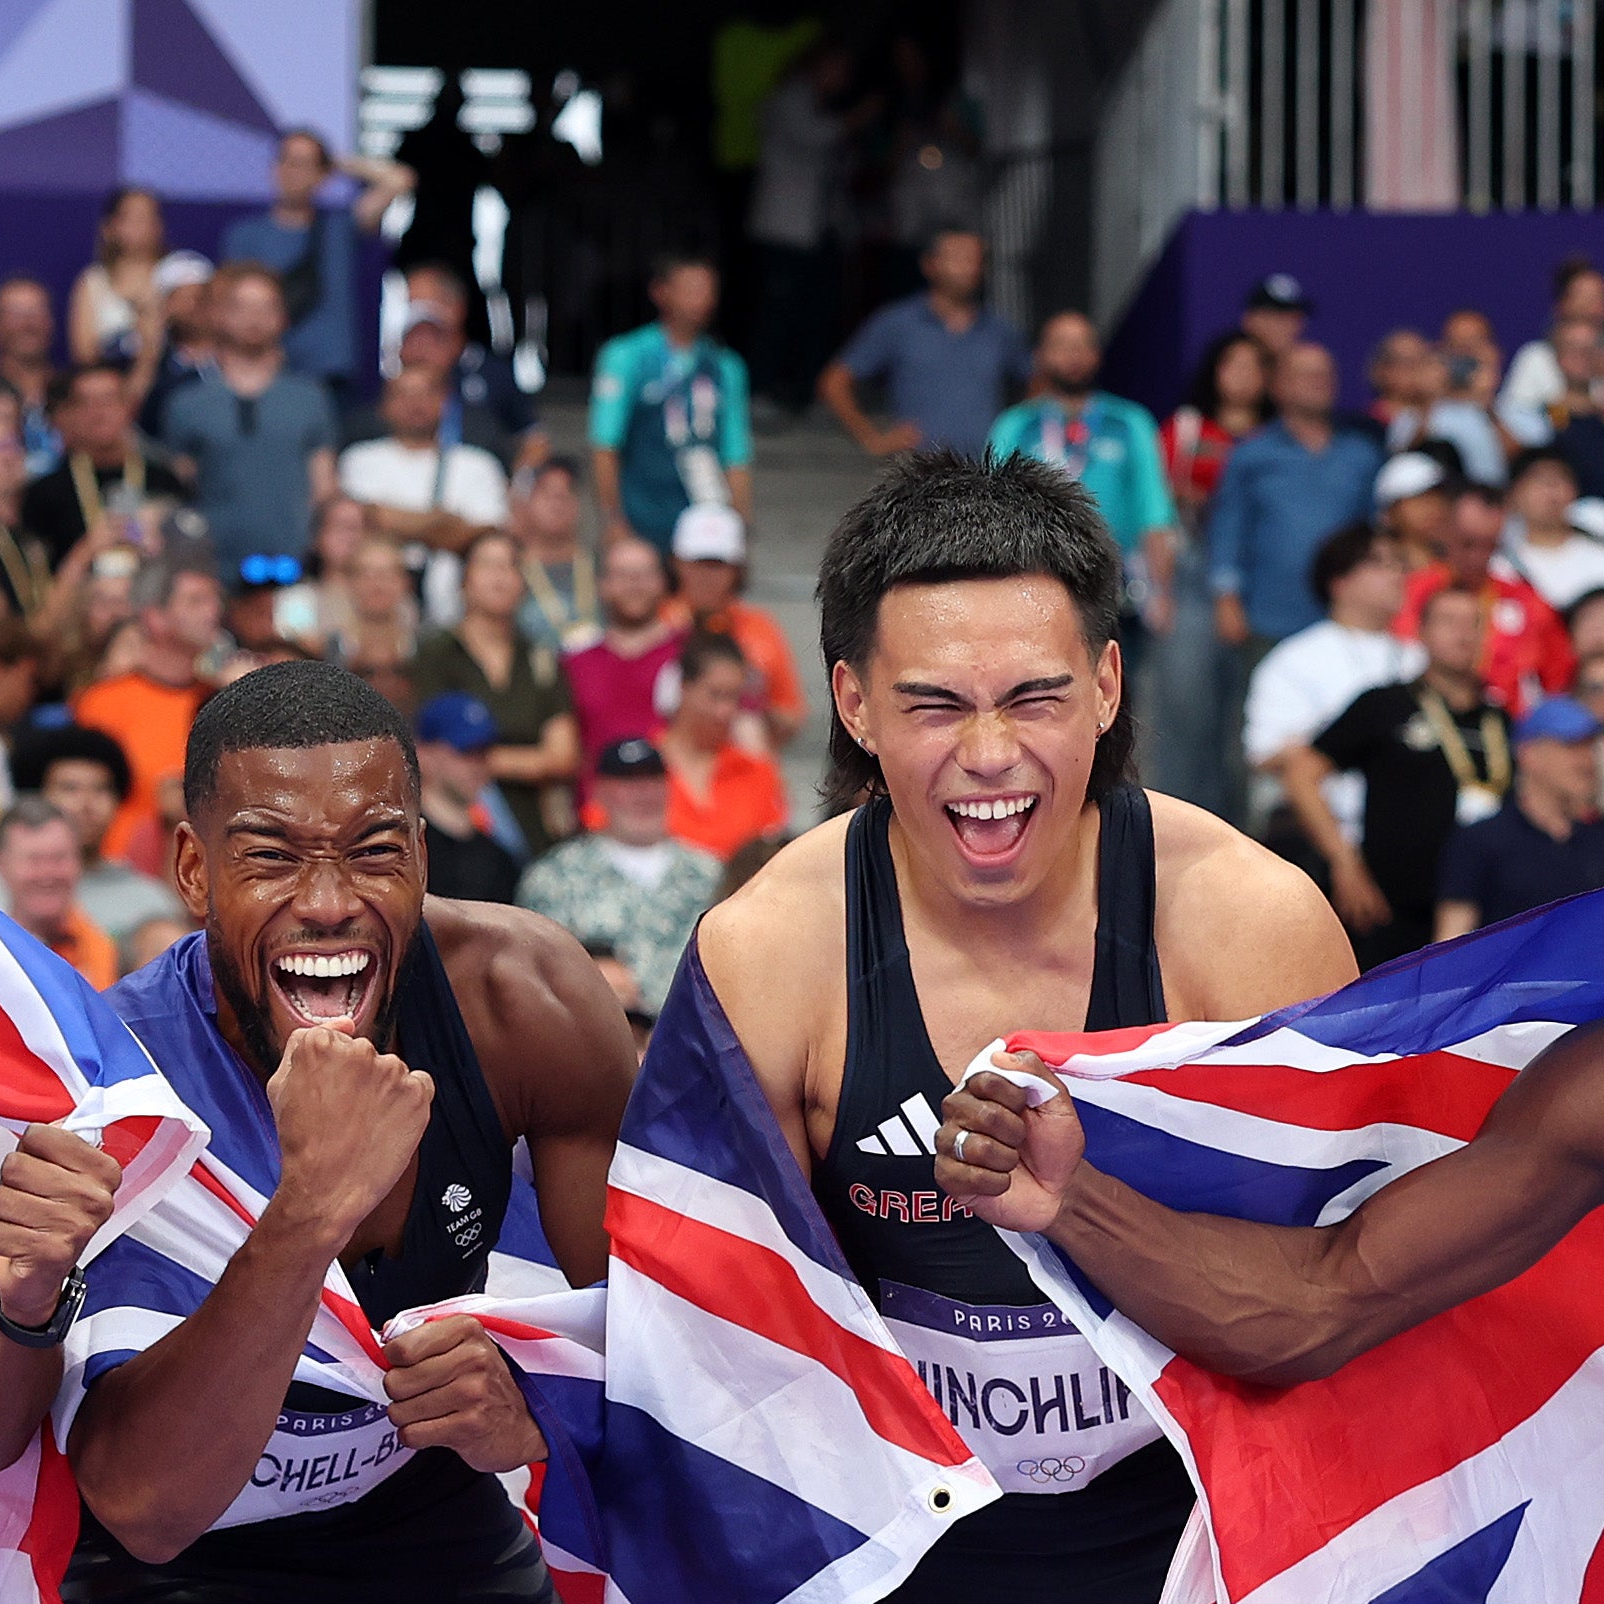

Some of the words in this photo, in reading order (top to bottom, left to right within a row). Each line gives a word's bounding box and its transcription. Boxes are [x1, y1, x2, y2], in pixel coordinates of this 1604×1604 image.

[849, 1182, 974, 1223] GREA
[446, 1214, 469, 1234] TEAM
[469, 1207, 483, 1220] GB
[953, 1309, 1031, 1332] PARIS
[276, 1415, 353, 1431] PARIS
[250, 1431, 404, 1492] CHELL-B
